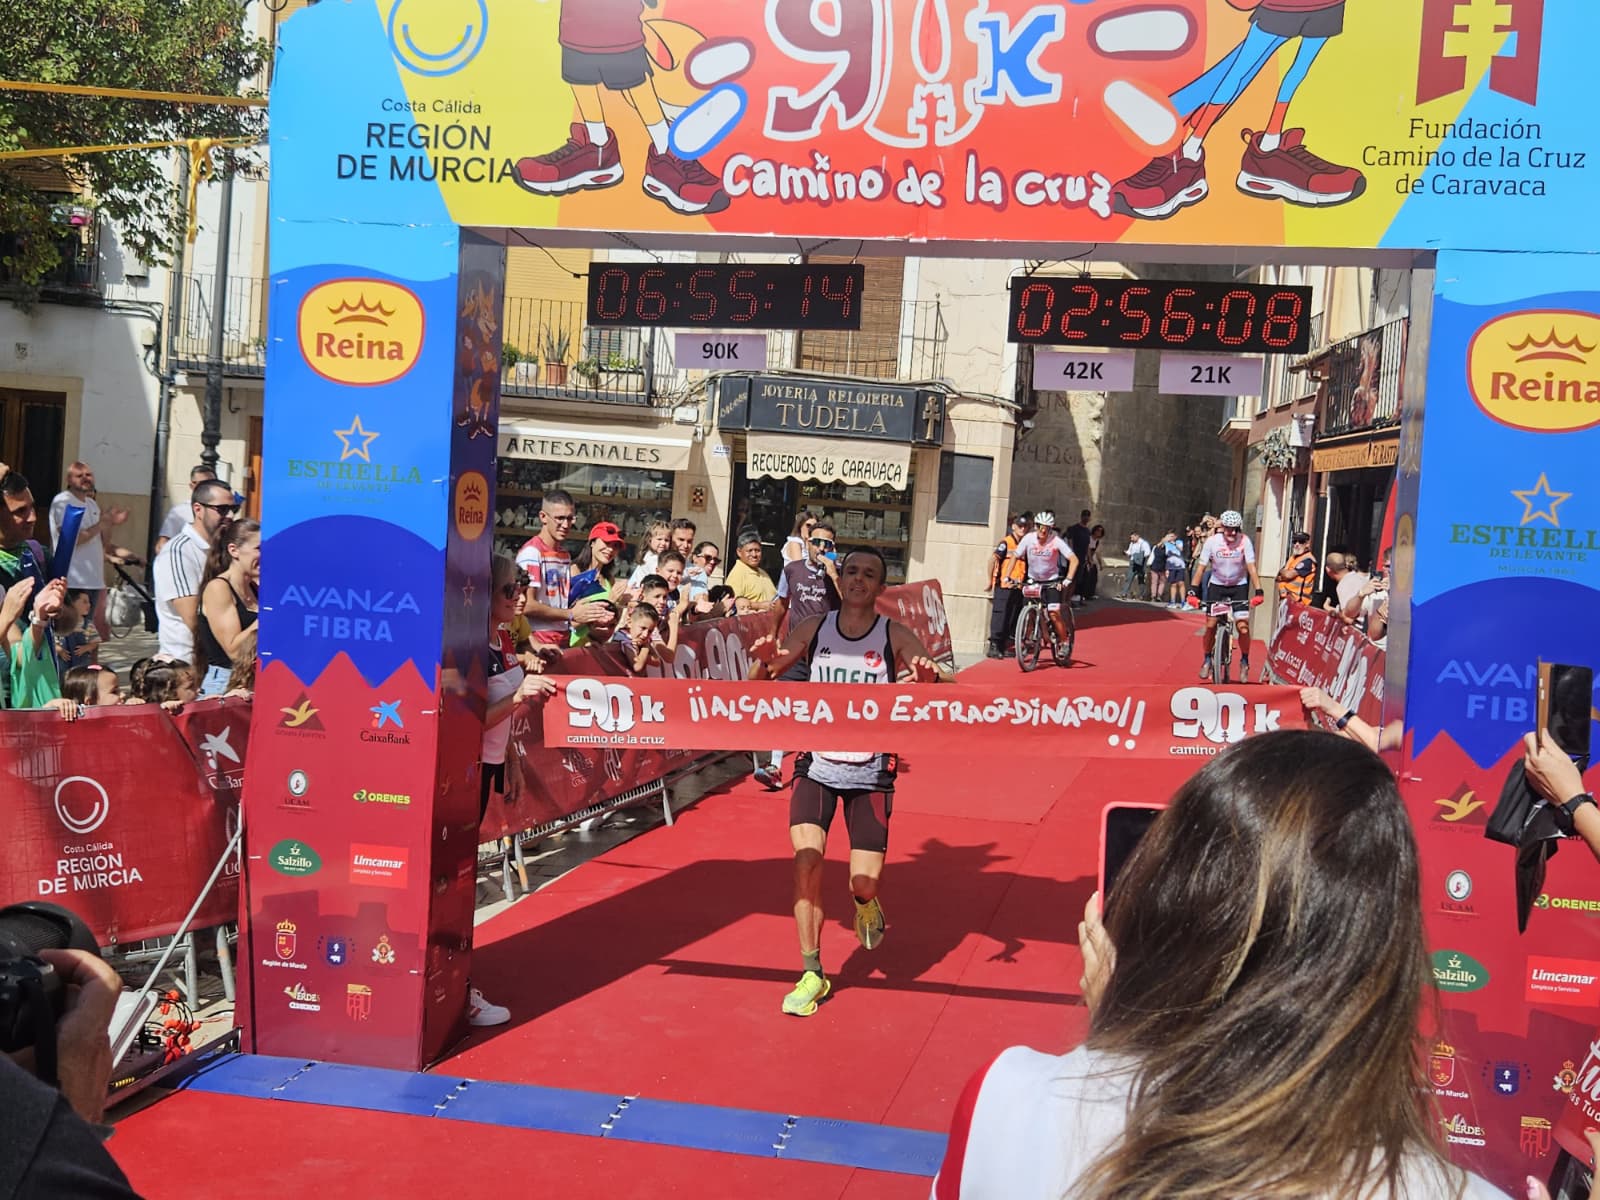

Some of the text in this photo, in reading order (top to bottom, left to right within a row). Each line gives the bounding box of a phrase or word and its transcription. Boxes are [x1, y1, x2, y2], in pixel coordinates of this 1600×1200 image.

[381, 98, 482, 114] Costa Cálida
[366, 119, 491, 151] REGIÓN
[1409, 117, 1541, 140] Fundación
[1362, 145, 1586, 169] Camino de la Cruz
[337, 154, 514, 184] DE MURCIA
[722, 152, 886, 202] Camino
[896, 166, 942, 208] de
[965, 154, 1002, 204] la
[1395, 173, 1546, 197] de Caravaca
[597, 269, 854, 321] 06:55:14
[1017, 284, 1302, 347] 02:56:08
[316, 332, 404, 361] Reina
[702, 341, 739, 360] 90K
[1063, 361, 1103, 380] 42K
[1190, 365, 1231, 384] 21K
[1490, 371, 1600, 404] Reina
[776, 403, 887, 434] TUDELA
[506, 438, 661, 463] ARTESANALES
[287, 459, 424, 485] ESTRELLA
[752, 452, 902, 483] RECUERDOS de CARAVACA
[459, 506, 484, 524] Reina
[1449, 524, 1600, 550] ESTRELL
[1489, 547, 1588, 562] DE LEVANTE
[279, 584, 422, 615] AVANZA
[303, 614, 393, 642] FIBRA
[847, 700, 879, 722] LO
[1466, 693, 1537, 724] FIB
[360, 730, 411, 745] CaixaBank
[567, 733, 665, 744] camino de la cruz
[1169, 744, 1217, 756] camino
[368, 792, 411, 805] ORENES
[64, 842, 114, 854] Costa Cálida
[57, 853, 123, 876] REGIÓN
[277, 855, 312, 868] Salzillo
[353, 854, 403, 869] Limcamar
[38, 867, 144, 895] DE MURCIA
[1551, 897, 1600, 911] ORENES
[1432, 967, 1477, 983] Salzillo
[1531, 968, 1594, 985] Limcamar
[1446, 1089, 1469, 1098] Murcia
